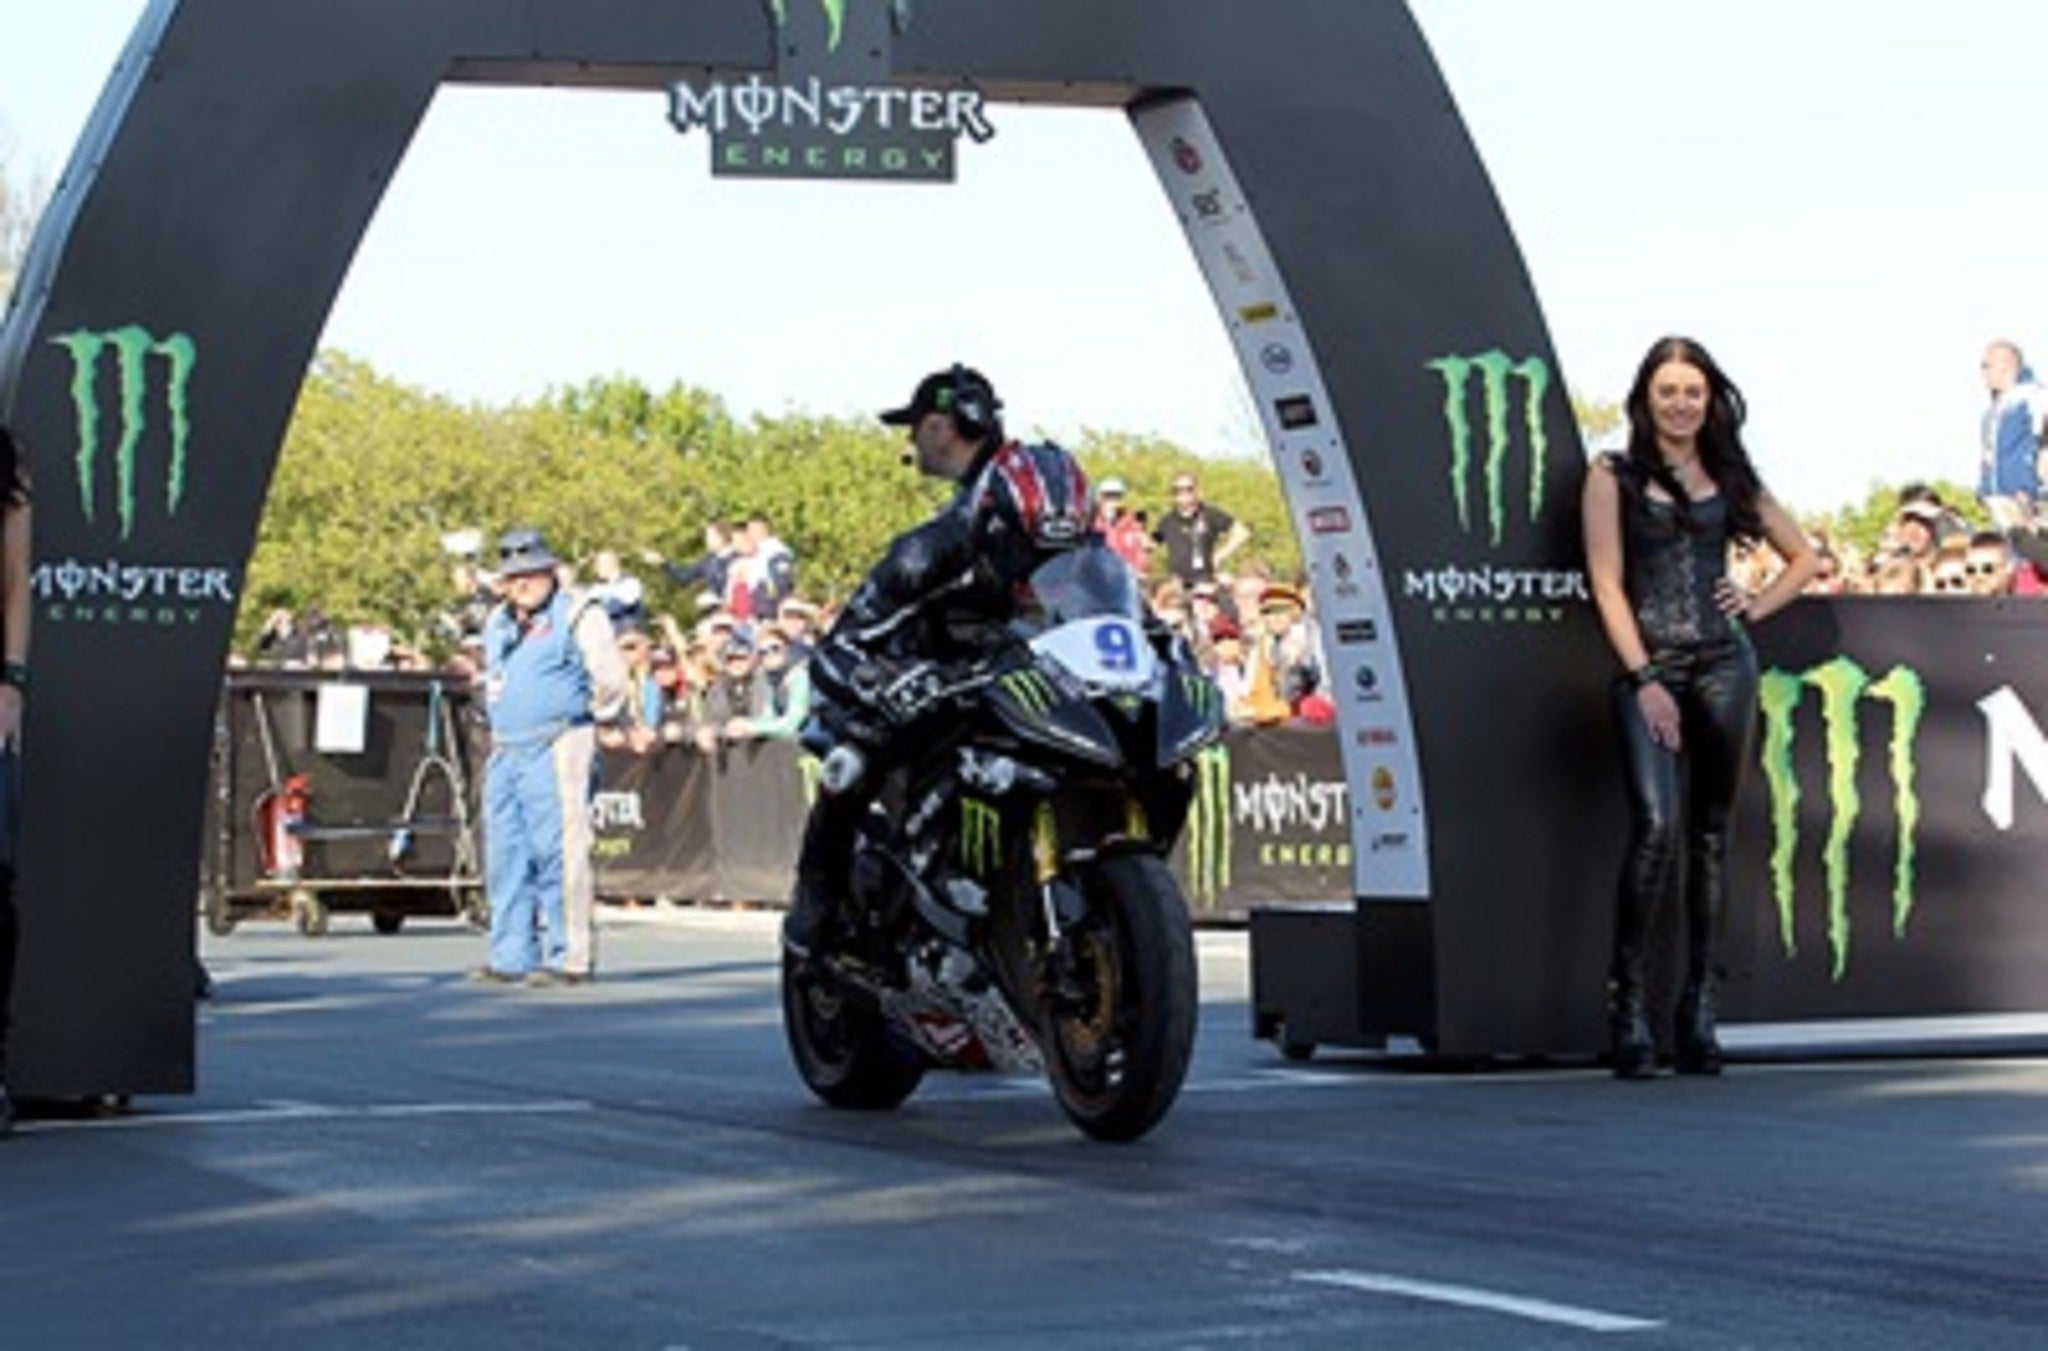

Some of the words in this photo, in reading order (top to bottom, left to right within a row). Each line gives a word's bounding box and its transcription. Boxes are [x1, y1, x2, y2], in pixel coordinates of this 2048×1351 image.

[674, 75, 990, 137] MONSTER
[725, 145, 944, 169] ENERGY
[1403, 564, 1589, 603] MONSTER
[1095, 622, 1137, 670] 9
